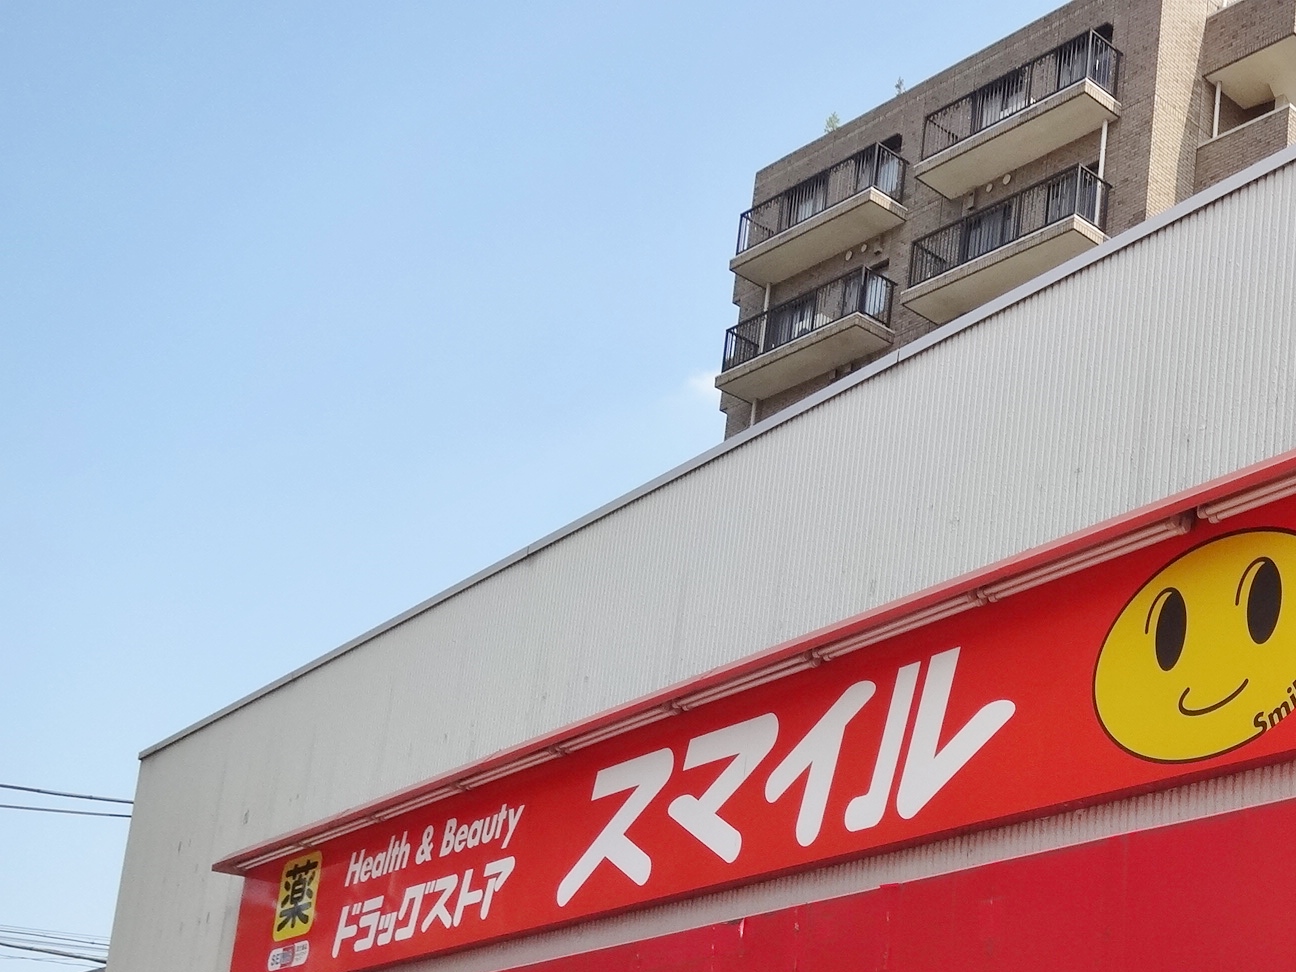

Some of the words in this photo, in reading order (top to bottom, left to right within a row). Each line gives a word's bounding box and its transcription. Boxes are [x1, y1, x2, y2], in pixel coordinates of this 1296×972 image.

[556, 646, 1015, 908] スマイル
[344, 831, 411, 888] Health
[415, 825, 435, 866] &
[439, 803, 526, 858] Beauty
[276, 859, 320, 933] 薬
[332, 856, 516, 959] ドラッグストア
